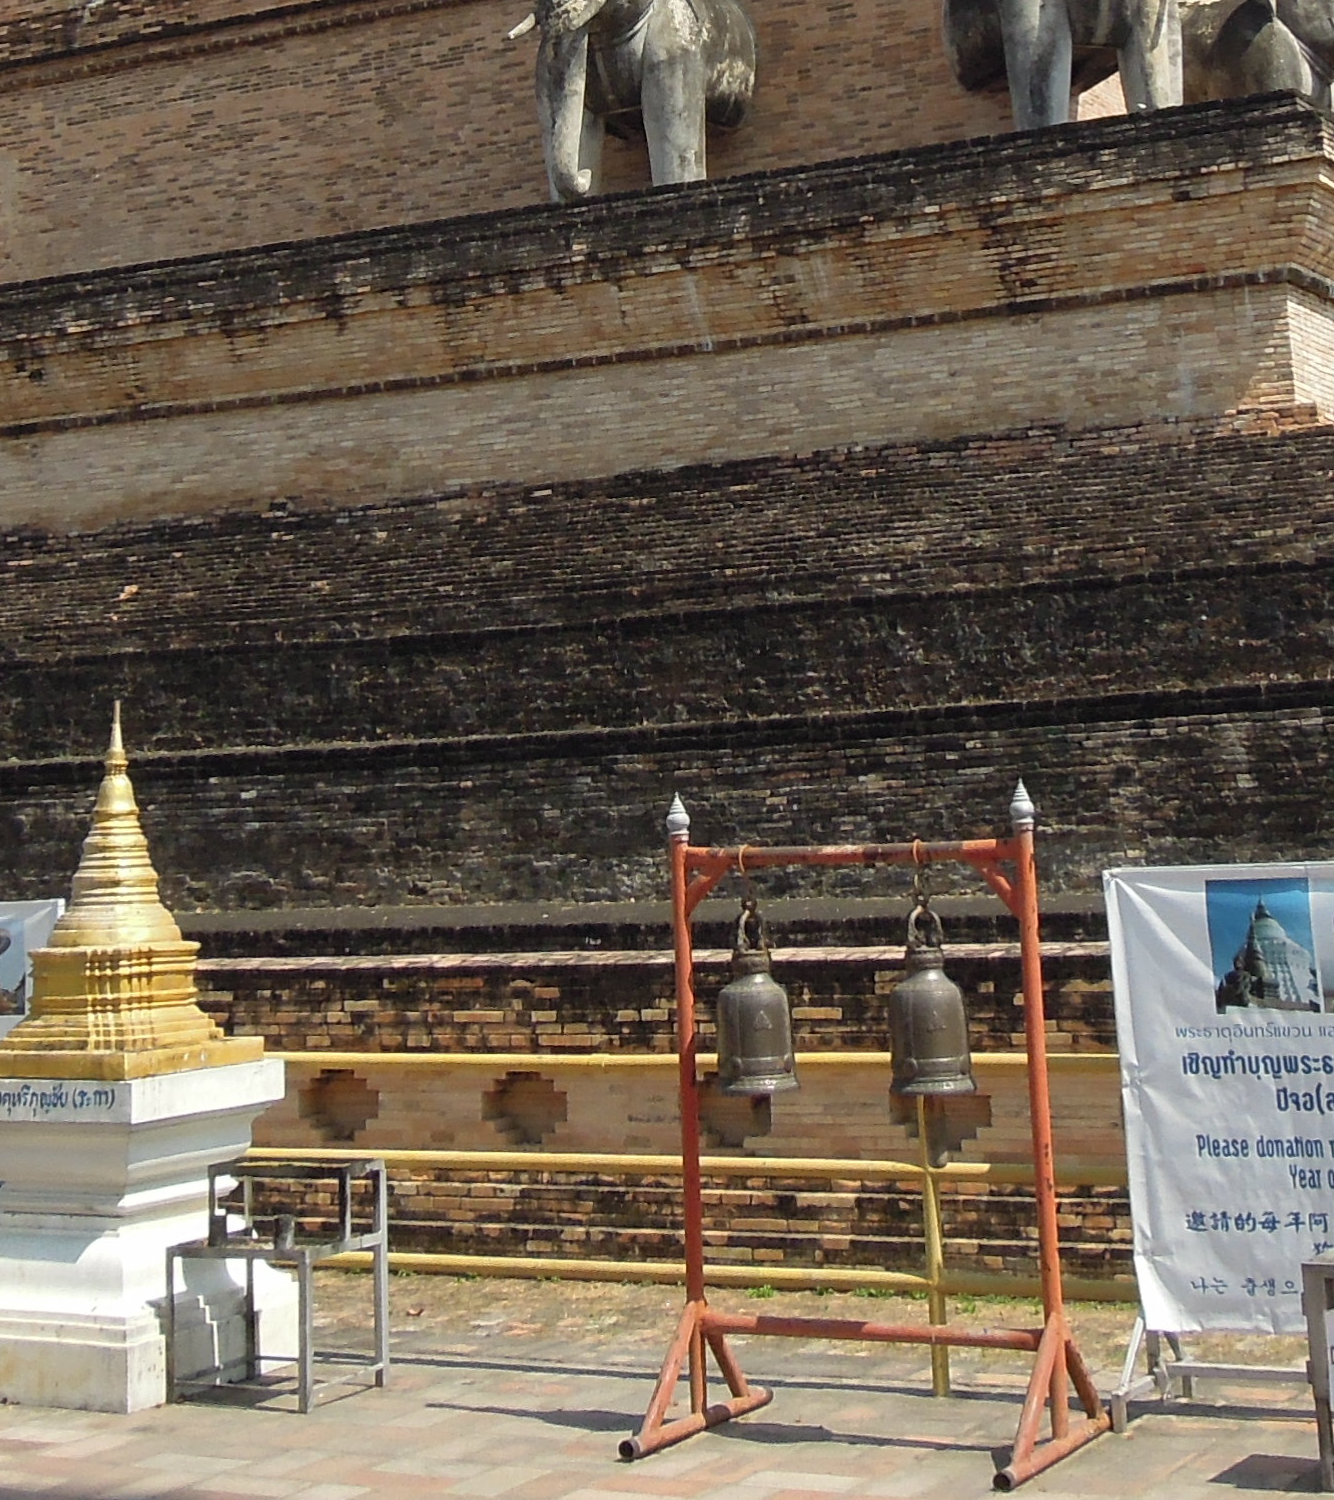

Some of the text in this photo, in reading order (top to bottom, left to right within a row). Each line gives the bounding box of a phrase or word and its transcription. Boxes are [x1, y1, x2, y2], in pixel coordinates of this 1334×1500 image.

[1195, 1134, 1249, 1158] Please
[1256, 1135, 1324, 1158] donation
[1289, 1164, 1322, 1190] Year
[1190, 1276, 1228, 1295] 나는
